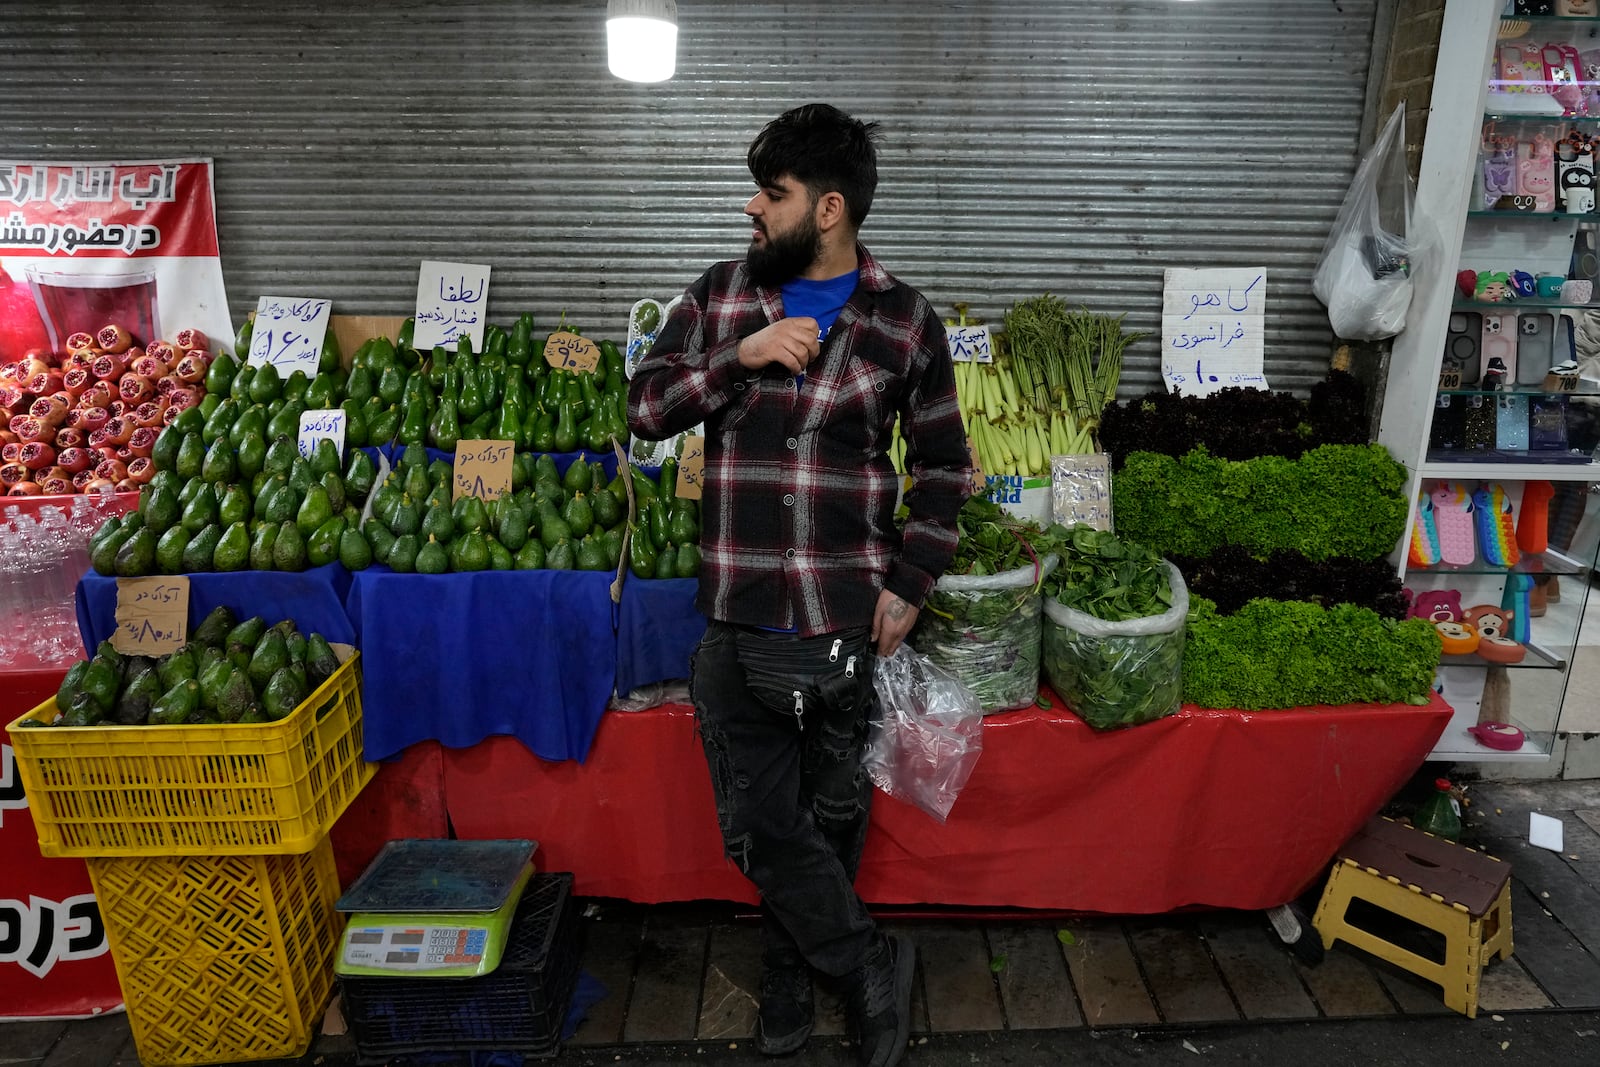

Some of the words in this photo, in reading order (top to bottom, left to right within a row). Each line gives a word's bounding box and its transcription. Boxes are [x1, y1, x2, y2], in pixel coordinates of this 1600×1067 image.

[53, 168, 112, 202] انار
[120, 162, 177, 207] آب
[0, 214, 46, 246] مش
[440, 276, 483, 303] لطفا
[1183, 275, 1262, 321] کاهو
[440, 307, 478, 326] فشار
[264, 329, 310, 363] ۱۶۰
[1172, 322, 1245, 350] فرانسوی
[558, 347, 577, 368] ۹۰
[953, 341, 973, 358] ۸۰
[1196, 359, 1219, 385] ۱۰
[1559, 377, 1578, 391] 700
[471, 474, 493, 499] ۸۰
[138, 618, 163, 643] ۸۰
